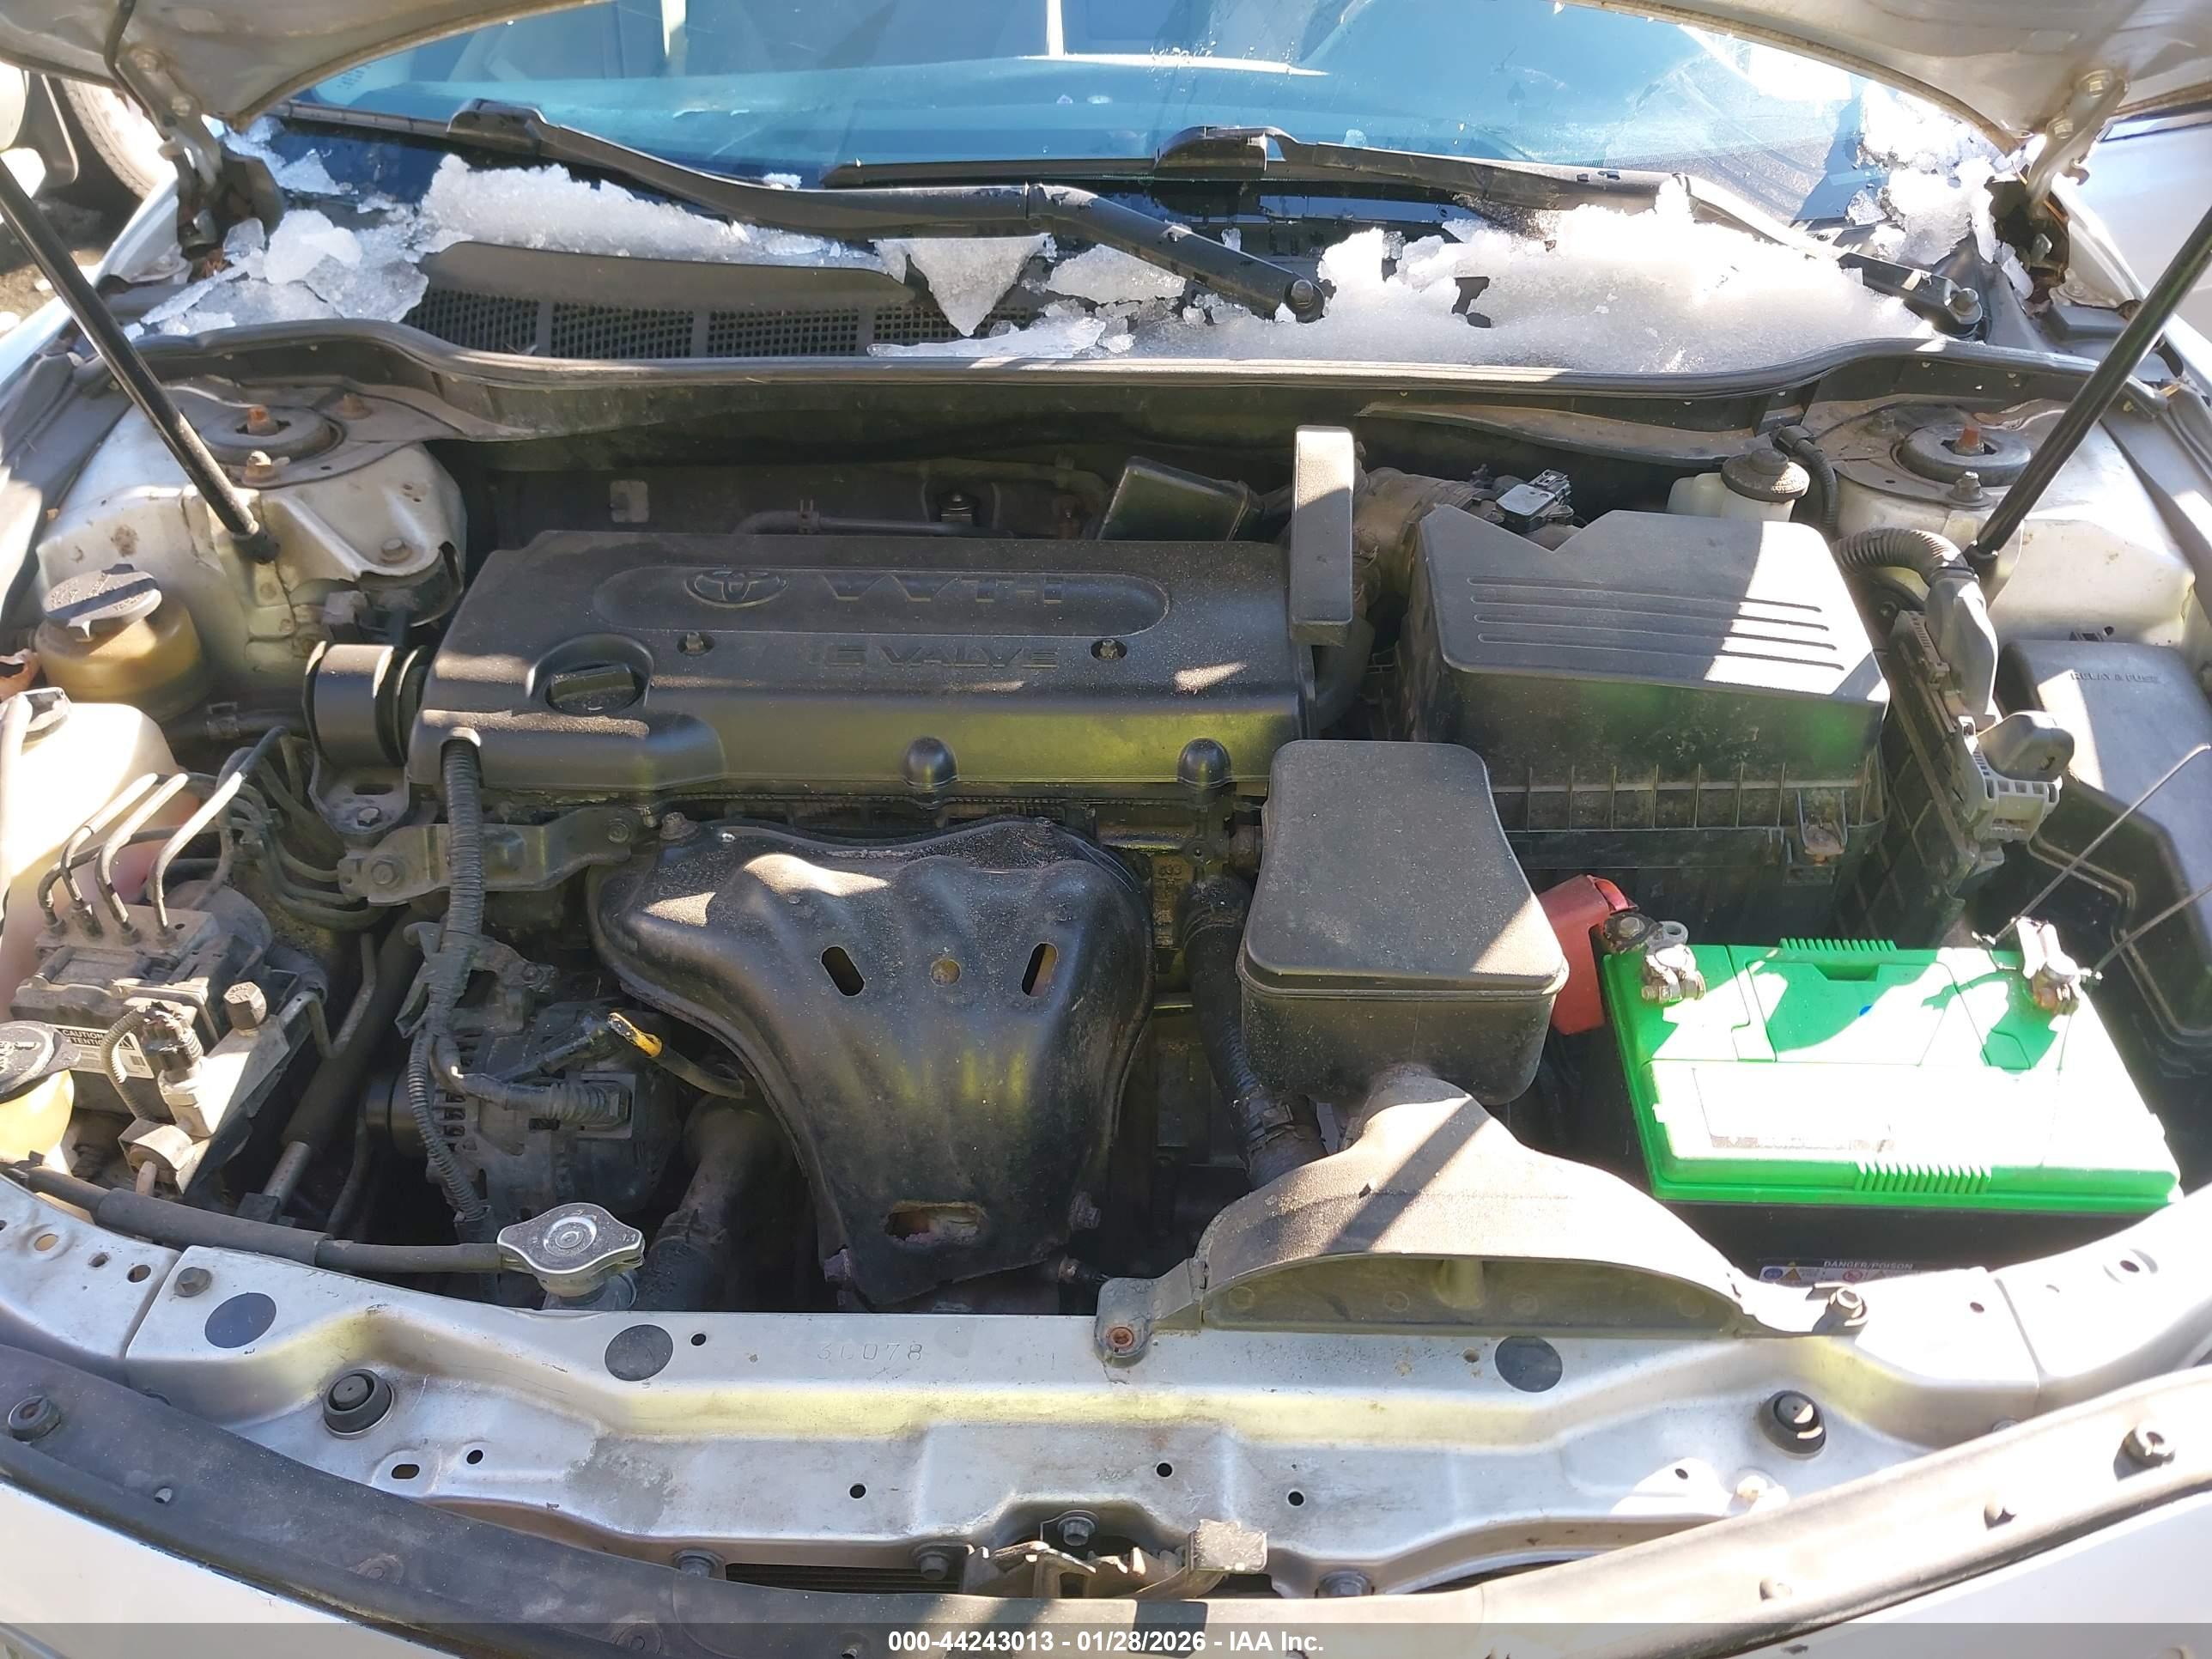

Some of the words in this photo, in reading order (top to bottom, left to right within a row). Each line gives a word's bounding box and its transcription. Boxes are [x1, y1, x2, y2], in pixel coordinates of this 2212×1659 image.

[878, 646, 1060, 668] VALVE
[2070, 672, 2111, 681] RELAY
[62, 1030, 104, 1039] CAUTION
